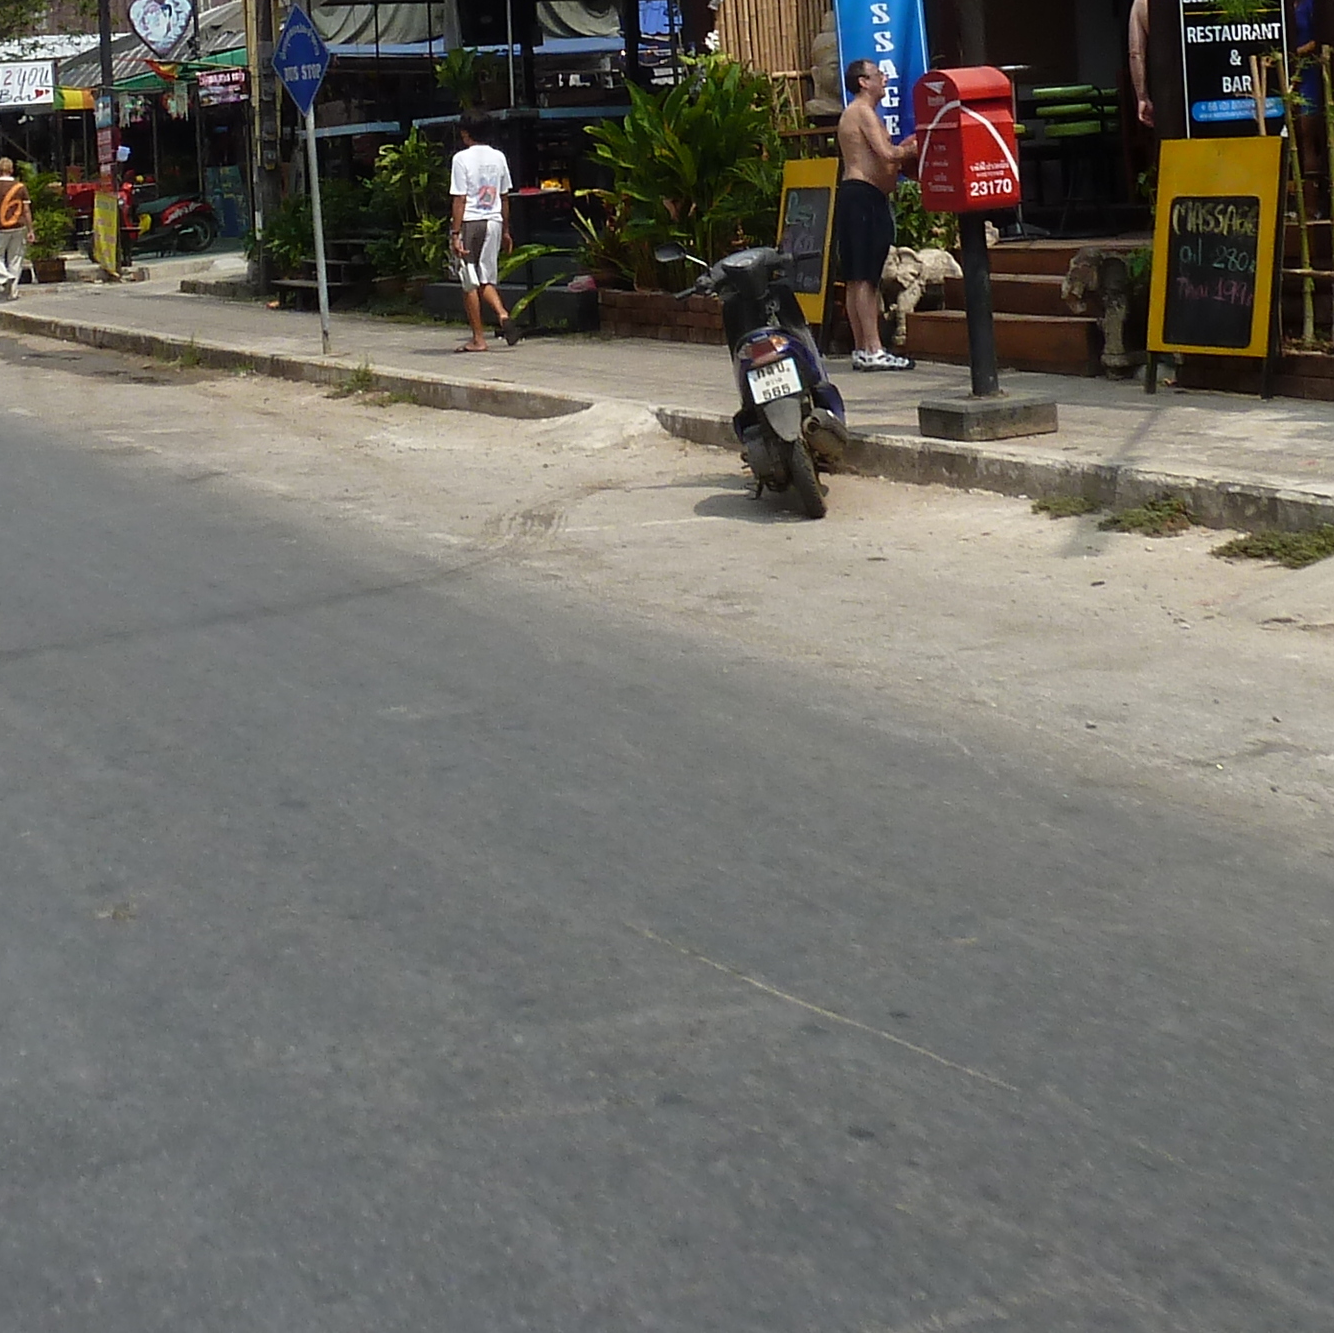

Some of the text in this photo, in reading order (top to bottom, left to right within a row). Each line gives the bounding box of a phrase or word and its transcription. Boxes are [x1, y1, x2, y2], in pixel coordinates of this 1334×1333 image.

[1187, 23, 1281, 43] RESTAURANT
[1230, 49, 1242, 66] &
[4, 70, 12, 86] 2
[1222, 75, 1252, 93] BAR
[970, 178, 1013, 197] 23170
[0, 182, 24, 226] 6
